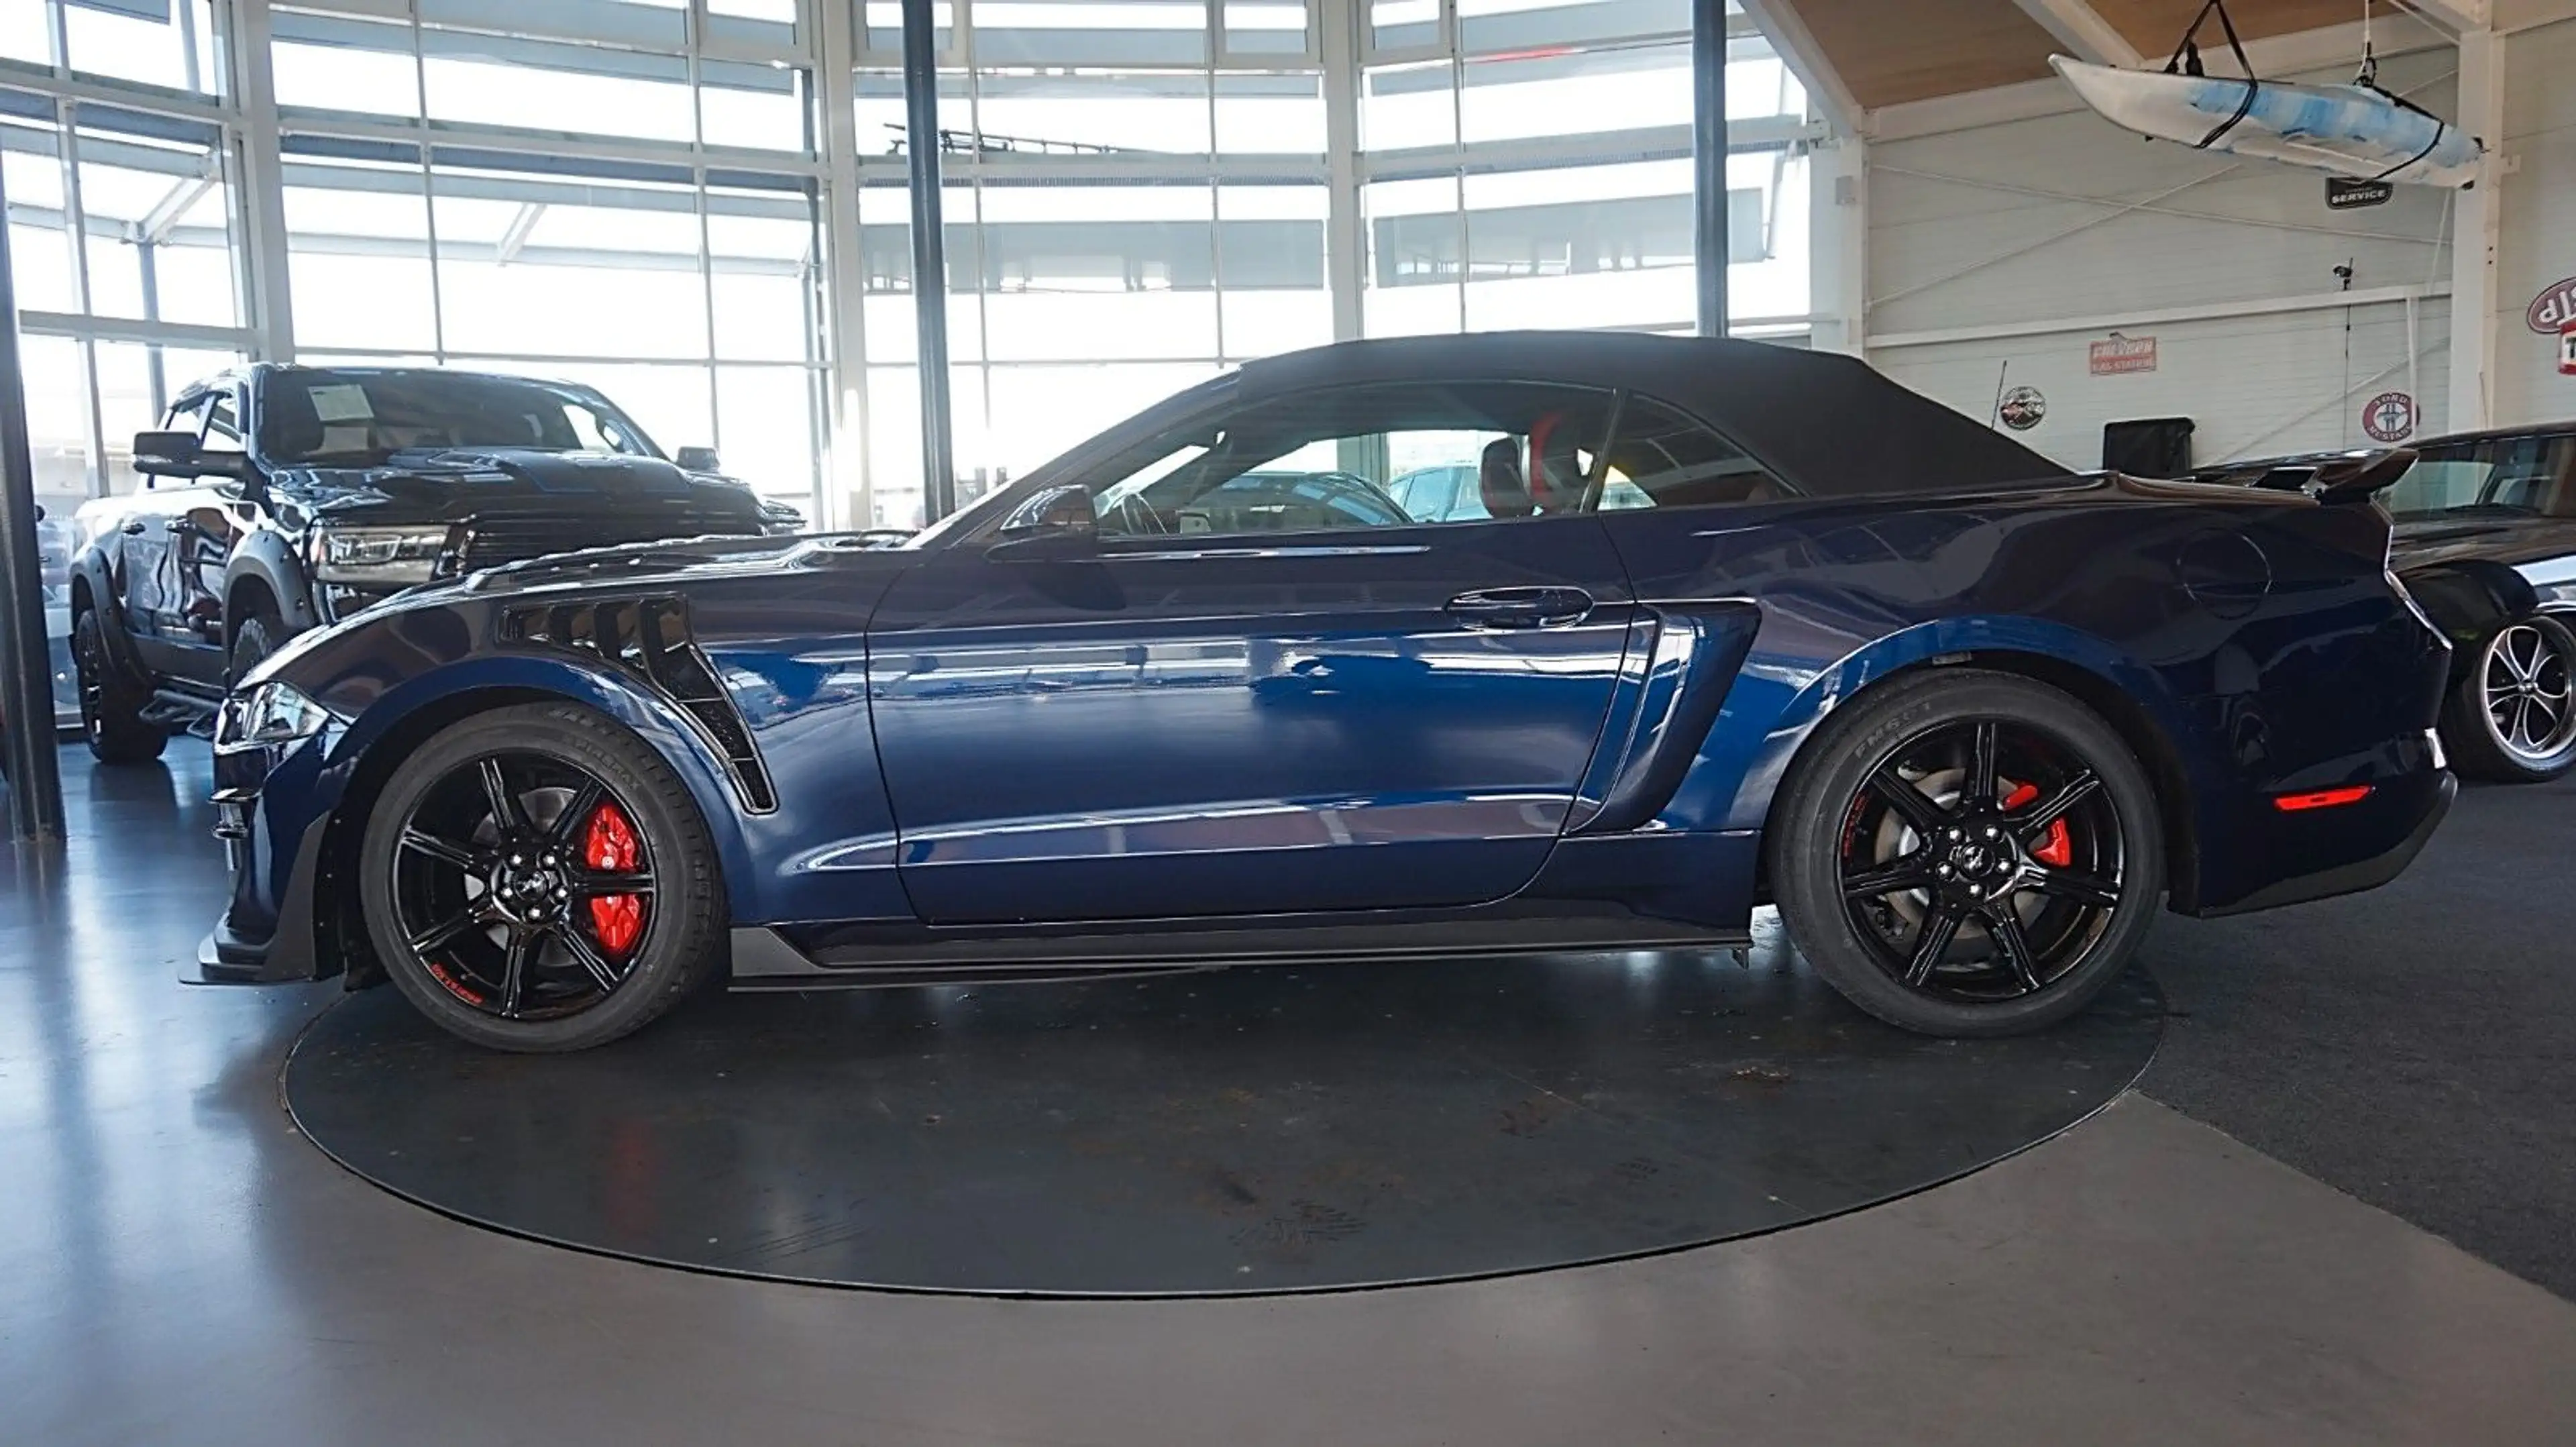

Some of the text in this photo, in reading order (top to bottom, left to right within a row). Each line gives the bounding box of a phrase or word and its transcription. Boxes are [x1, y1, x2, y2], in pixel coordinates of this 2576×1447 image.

[2331, 189, 2387, 204] SERVICE
[2538, 286, 2576, 325] TP
[2372, 394, 2408, 406] FORD
